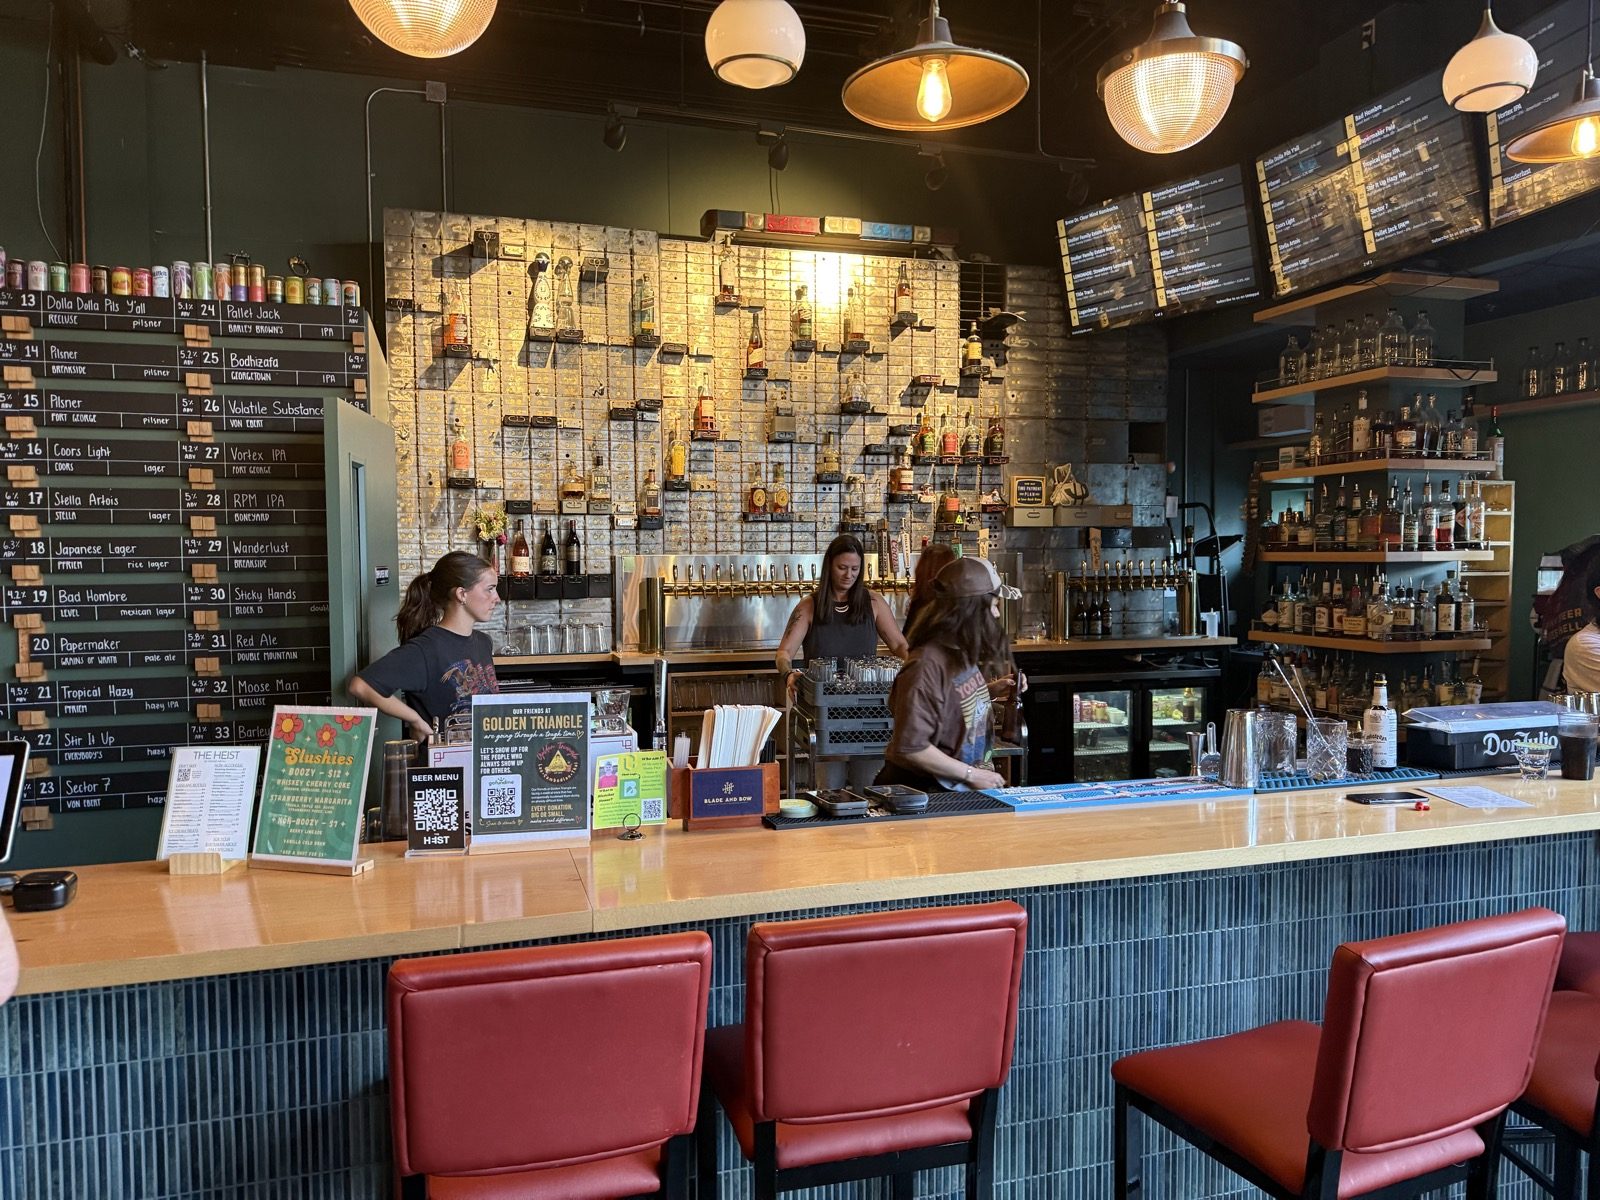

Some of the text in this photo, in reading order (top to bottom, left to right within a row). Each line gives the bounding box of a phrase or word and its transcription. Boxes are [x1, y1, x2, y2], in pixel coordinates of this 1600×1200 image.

[1498, 104, 1522, 120] Vortex IPA
[1504, 168, 1532, 184] Wanderlust
[1370, 204, 1385, 215] Sector
[20, 294, 36, 306] 13
[47, 295, 146, 314] Dolla Dolla Pils Y'all
[200, 304, 216, 317] 24
[227, 305, 280, 320] Pallet Jack
[132, 319, 162, 329] pilsner
[228, 324, 284, 334] BARLEY BROWN'S
[320, 327, 334, 337] IPA
[25, 346, 39, 358] 14
[50, 346, 78, 360] Pilsner
[202, 352, 219, 364] 25
[230, 352, 279, 368] Bodhizafa
[52, 365, 86, 374] BREAKSIDE
[144, 368, 170, 377] pilsner
[230, 370, 272, 381] GEORGETOWN
[322, 374, 336, 383] IPA
[23, 394, 38, 407] 15
[50, 394, 82, 408] Pilsner
[204, 399, 220, 412] 26
[228, 400, 325, 416] Volatile Substance
[51, 413, 97, 423] FORT GEORGE
[142, 416, 170, 425] pilsner
[230, 419, 264, 428] VON EBERT
[27, 443, 42, 456] 16
[54, 444, 112, 460] Coors Light
[205, 446, 220, 460] 27
[230, 448, 287, 461] Vortex IPA
[54, 462, 74, 472] COORS
[144, 464, 166, 474] lager
[232, 466, 272, 474] FORT GEORGE
[28, 492, 43, 505] 17
[54, 492, 119, 506] Stella Artois
[207, 494, 221, 506] 28
[234, 493, 285, 508] RPM IPA
[55, 511, 77, 520] STELLA
[148, 512, 171, 521] lager
[234, 513, 270, 522] BONEYARD
[30, 541, 46, 554] 18
[55, 542, 137, 557] Japanese Lager
[208, 540, 222, 552] 29
[232, 541, 290, 554] Wanderlust
[148, 560, 170, 570] lager
[234, 559, 267, 569] BREAKSIDE
[33, 590, 48, 603] 19
[58, 589, 128, 604] Bad Hombre
[210, 588, 226, 600] 30
[234, 587, 297, 602] Sticky Hands
[60, 609, 80, 618] LEVEL
[156, 608, 176, 618] lager
[235, 606, 255, 615] BLOCK
[33, 638, 50, 651] 20
[60, 638, 120, 653] Papermaker
[211, 635, 226, 648] 31
[236, 634, 278, 647] Red Ale
[61, 656, 118, 666] GRAINS OF WRATH
[144, 654, 176, 662] pale ale
[237, 651, 298, 661] DOUBLE MOUNTAIN
[38, 686, 52, 699] 21
[213, 680, 228, 693] 32
[238, 679, 299, 694] Moose Man
[61, 686, 134, 700] Tropical Hazy
[145, 701, 165, 710] hazy
[483, 714, 583, 732] GOLDEN TRIANGLE
[64, 731, 115, 747] Stir It Up
[215, 727, 230, 739] 33
[496, 733, 512, 743] going
[514, 730, 538, 742] through
[545, 730, 562, 740] tough
[37, 734, 52, 746] 22
[64, 752, 103, 761] EVERYBODY'S
[147, 747, 166, 757] hazy
[194, 751, 240, 760] THE HEIST
[284, 747, 354, 766] Slushies
[288, 768, 316, 777] BOOZY
[434, 774, 459, 782] MENU
[40, 782, 55, 794] 23
[66, 777, 111, 795] Sector 7
[277, 779, 303, 787] WHISKEY
[66, 800, 80, 809] VON
[270, 794, 353, 806] STRAWBERRY MARGARITA
[277, 817, 319, 826] NON-BOOZY
